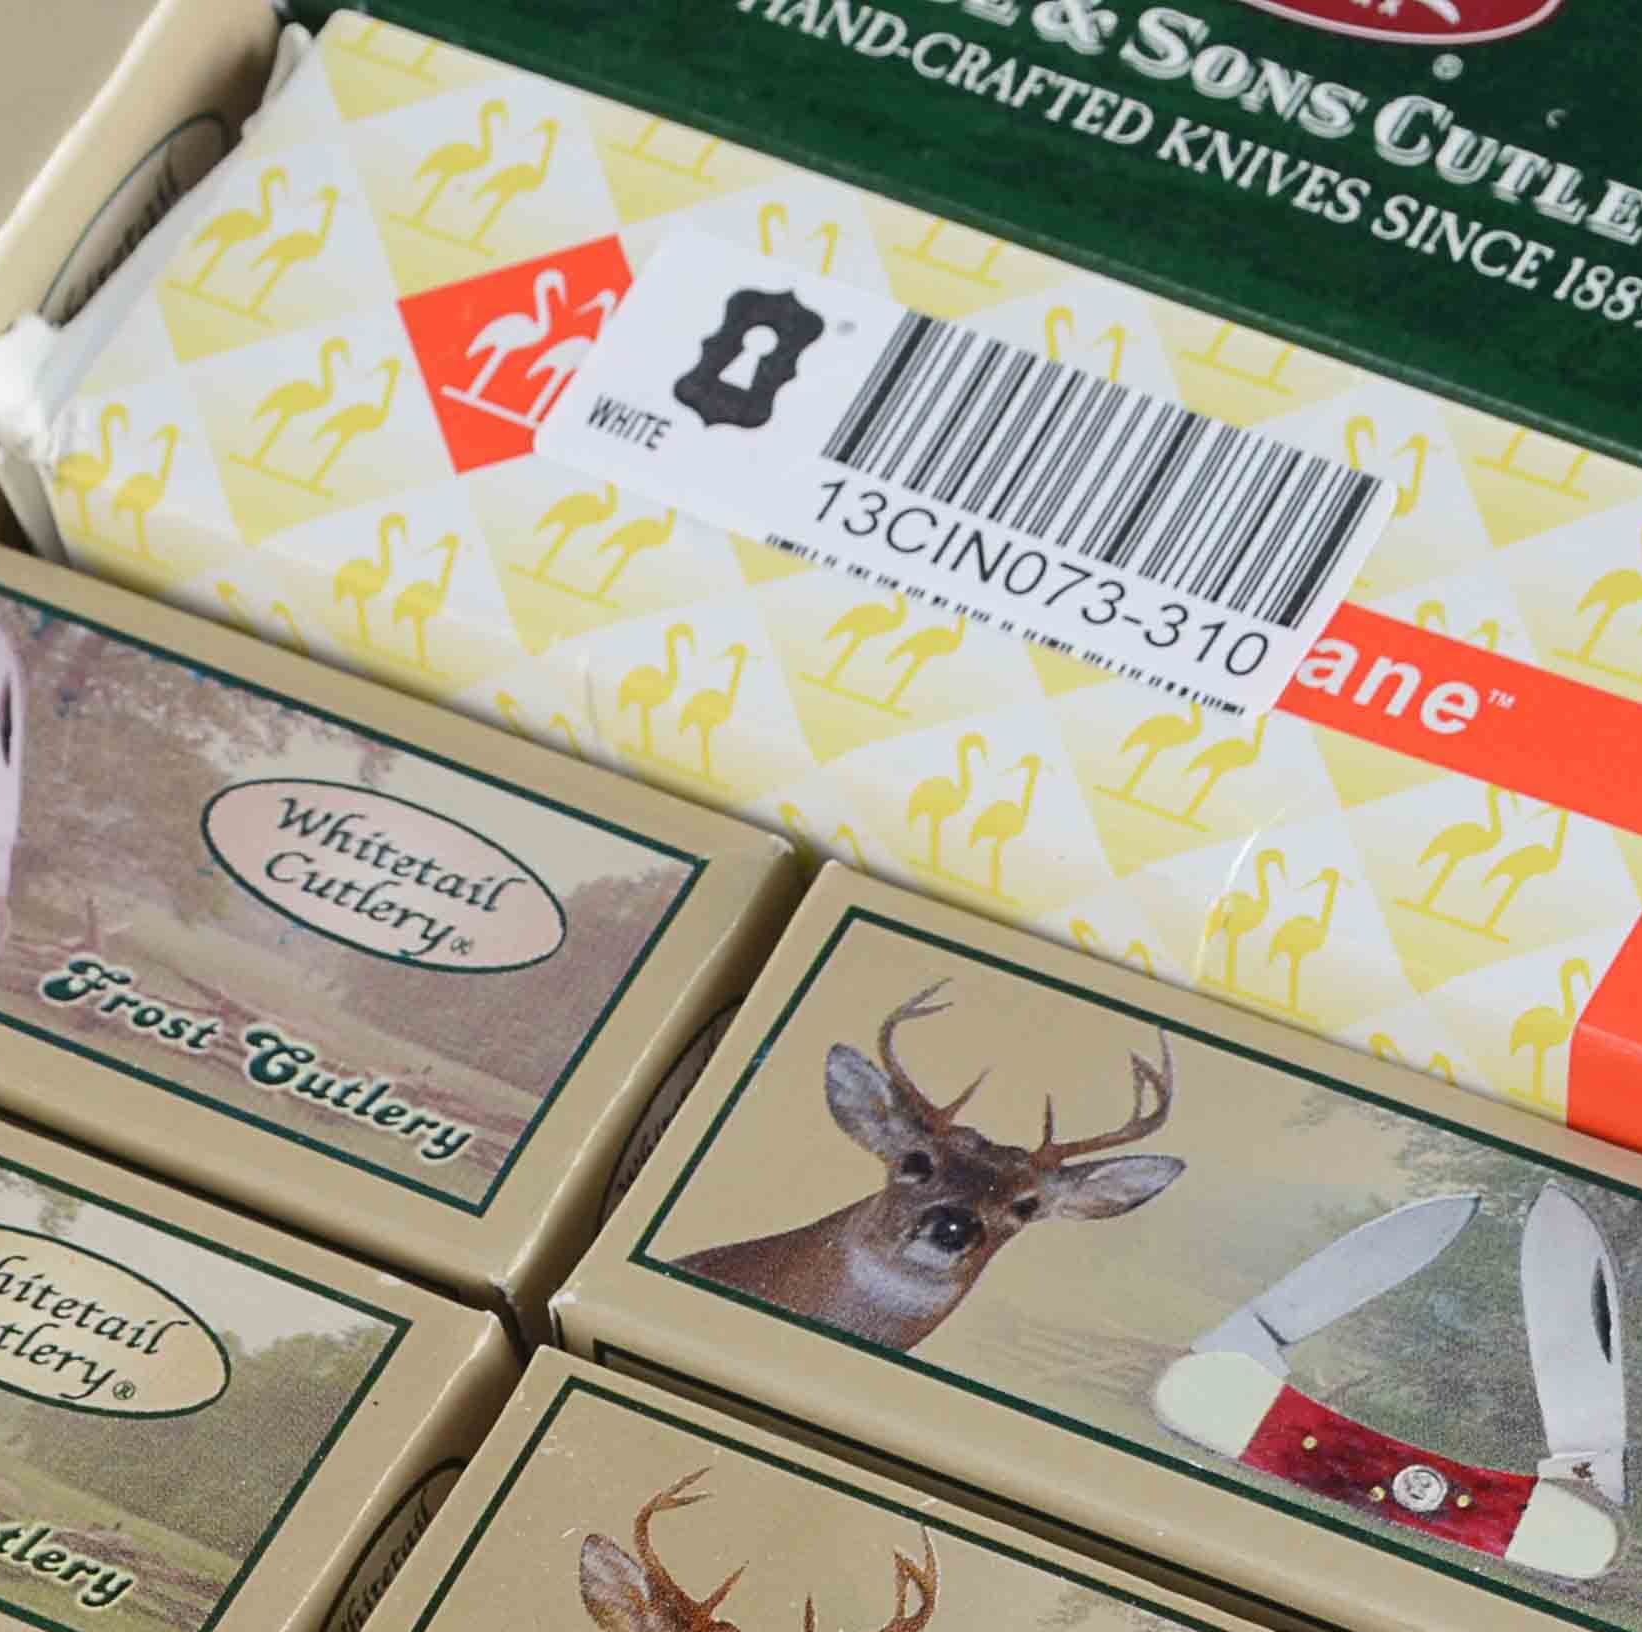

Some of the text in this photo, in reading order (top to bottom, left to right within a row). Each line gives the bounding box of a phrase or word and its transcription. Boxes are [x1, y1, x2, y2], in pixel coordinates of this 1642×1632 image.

[1158, 116, 1370, 225] KNIVES
[1370, 195, 1554, 290] SINCE
[586, 395, 671, 452] WHITE
[811, 478, 1269, 679] 13CIN073-310
[277, 798, 525, 914] Whitetail
[43, 954, 221, 1052] Frost
[246, 1026, 475, 1161] Cutlery
